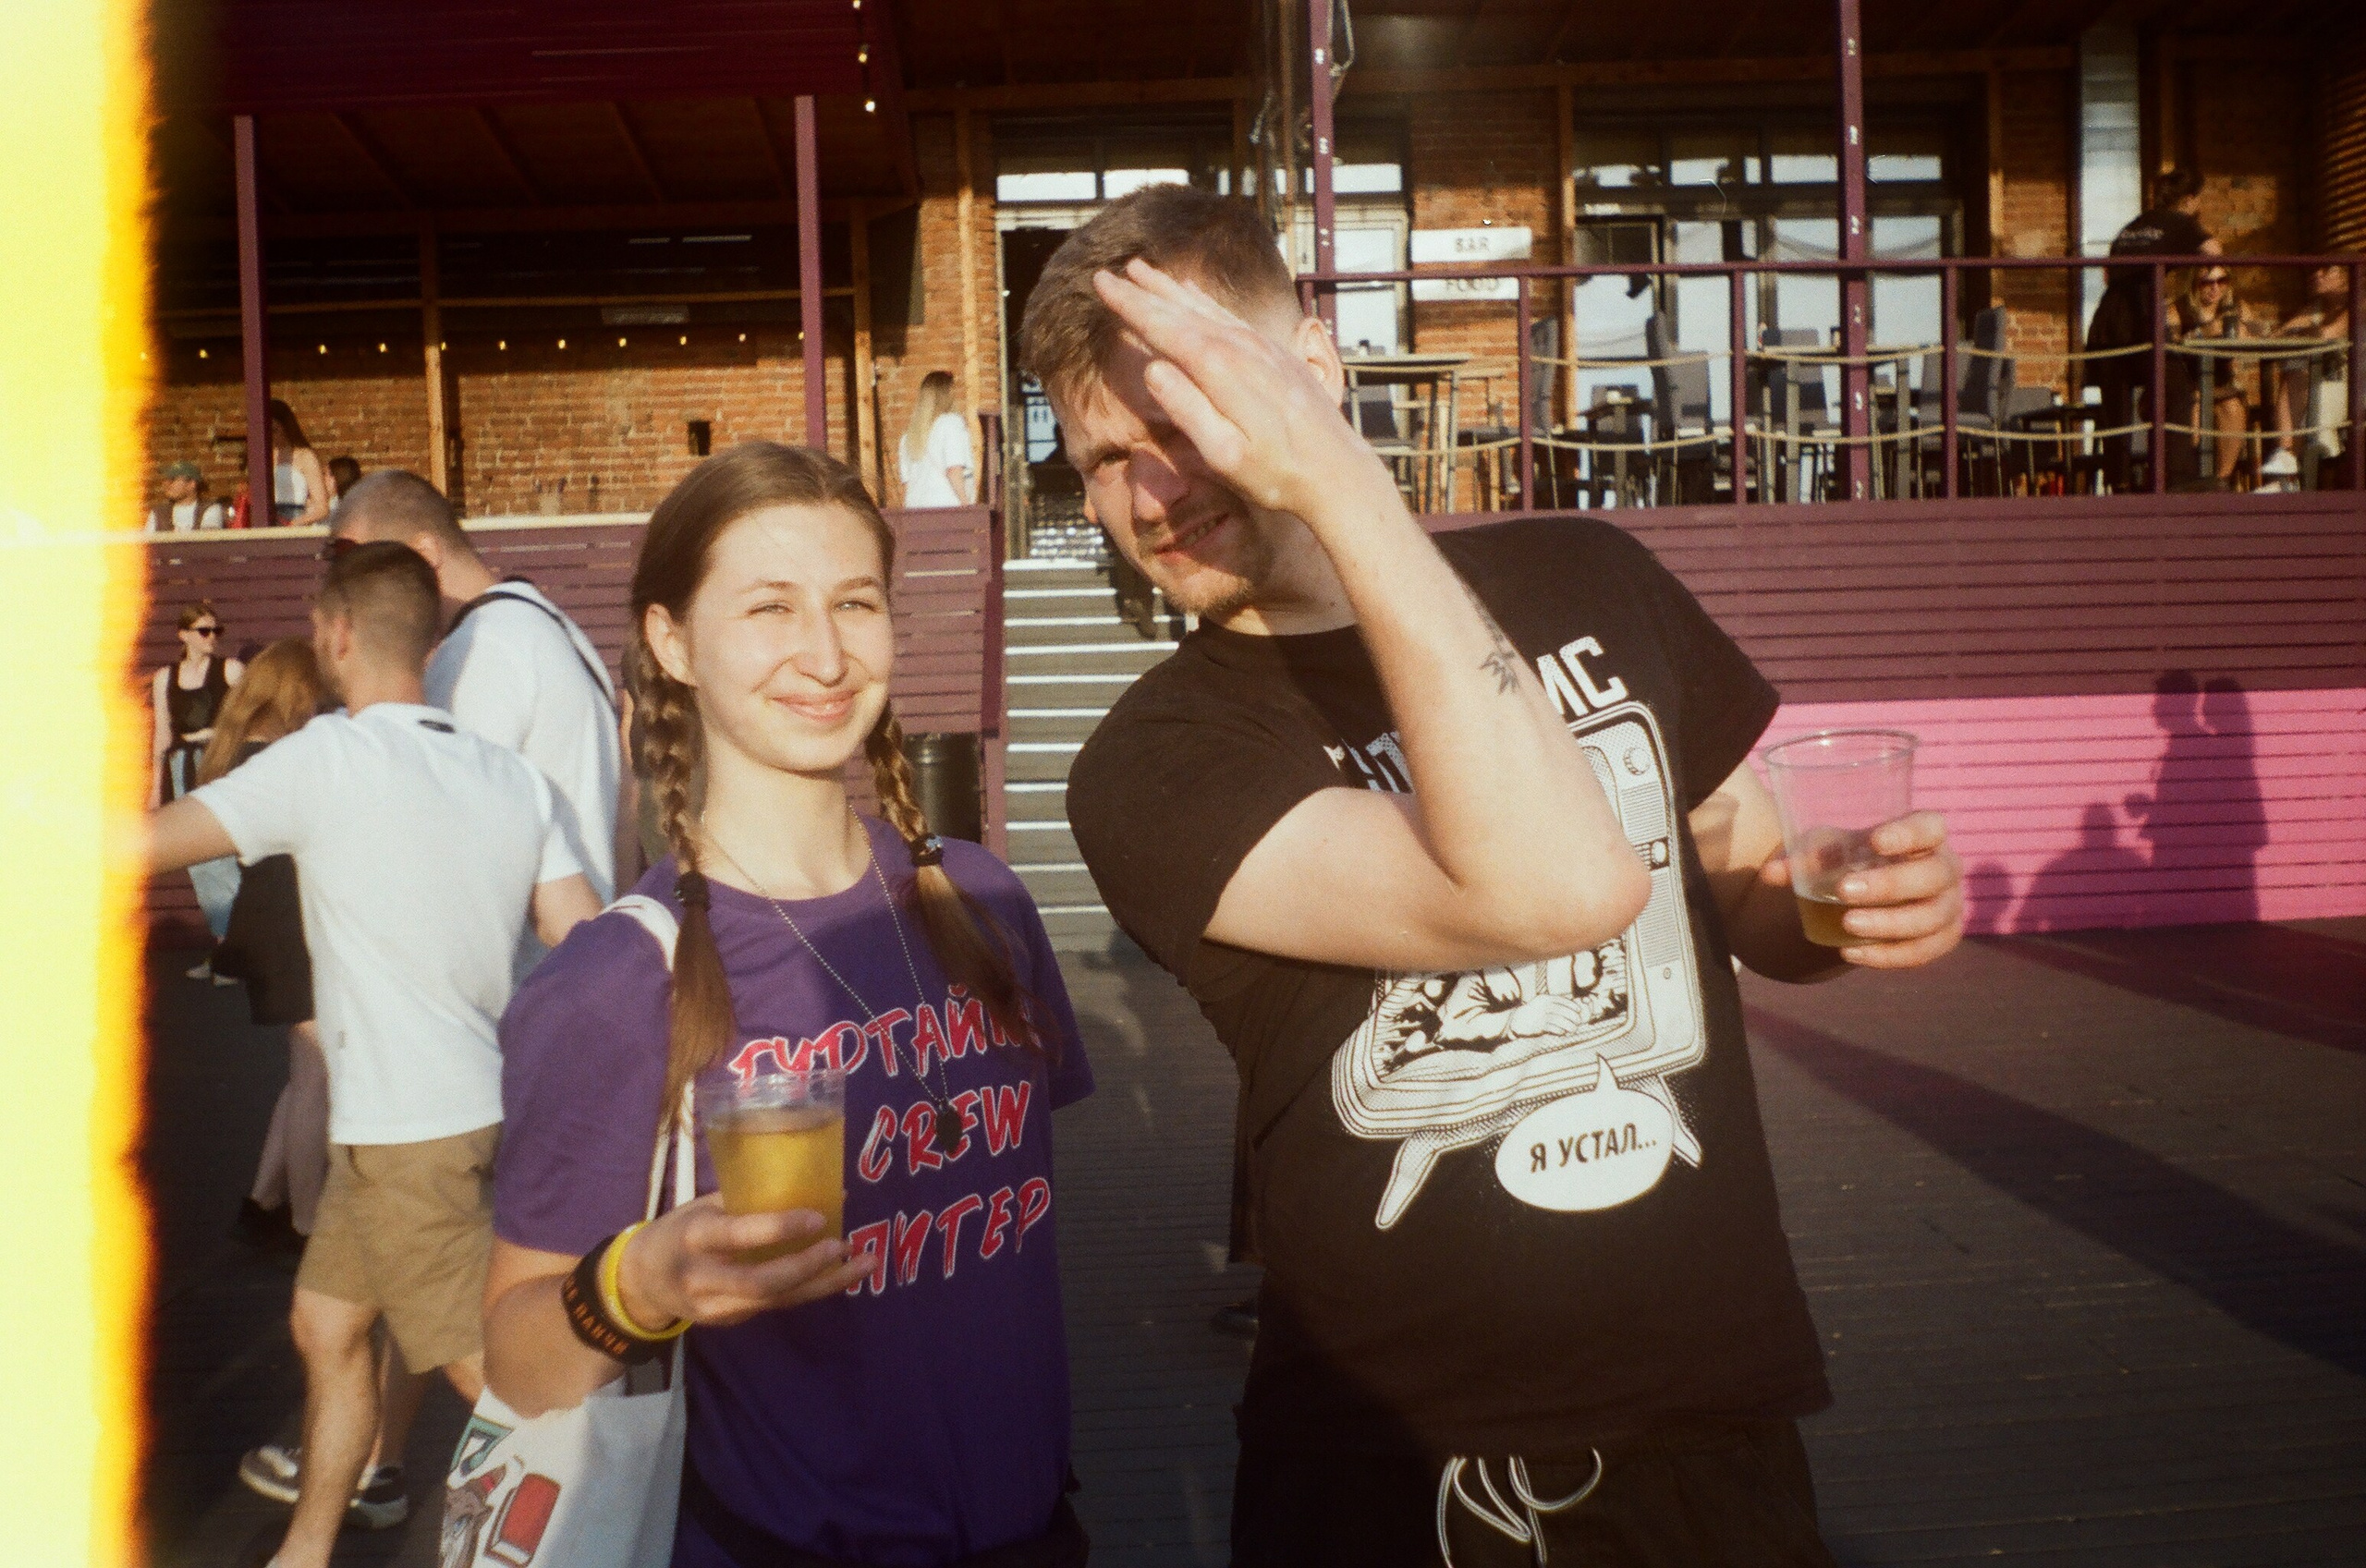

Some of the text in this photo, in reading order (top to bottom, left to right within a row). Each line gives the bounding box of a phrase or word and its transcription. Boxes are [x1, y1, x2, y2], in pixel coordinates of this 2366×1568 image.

[859, 1080, 1031, 1183] CREW
[1530, 1142, 1547, 1173] Я
[846, 1177, 1051, 1295] ПИТЕР
